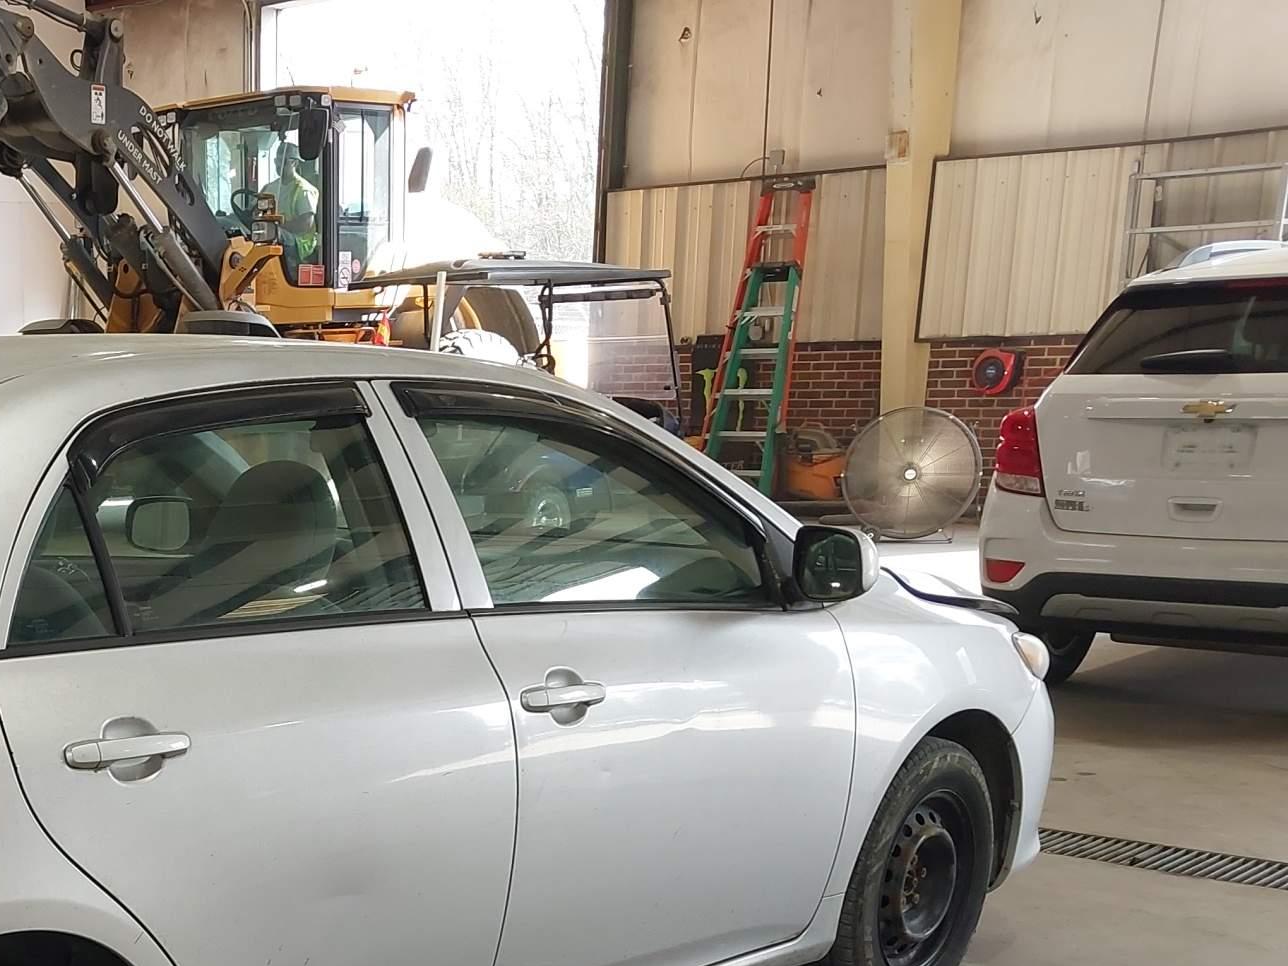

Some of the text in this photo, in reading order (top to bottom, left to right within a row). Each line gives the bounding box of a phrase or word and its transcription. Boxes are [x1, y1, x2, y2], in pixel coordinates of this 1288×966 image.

[117, 130, 163, 185] UNDER MAST
[139, 105, 187, 172] DO NOT WALK
